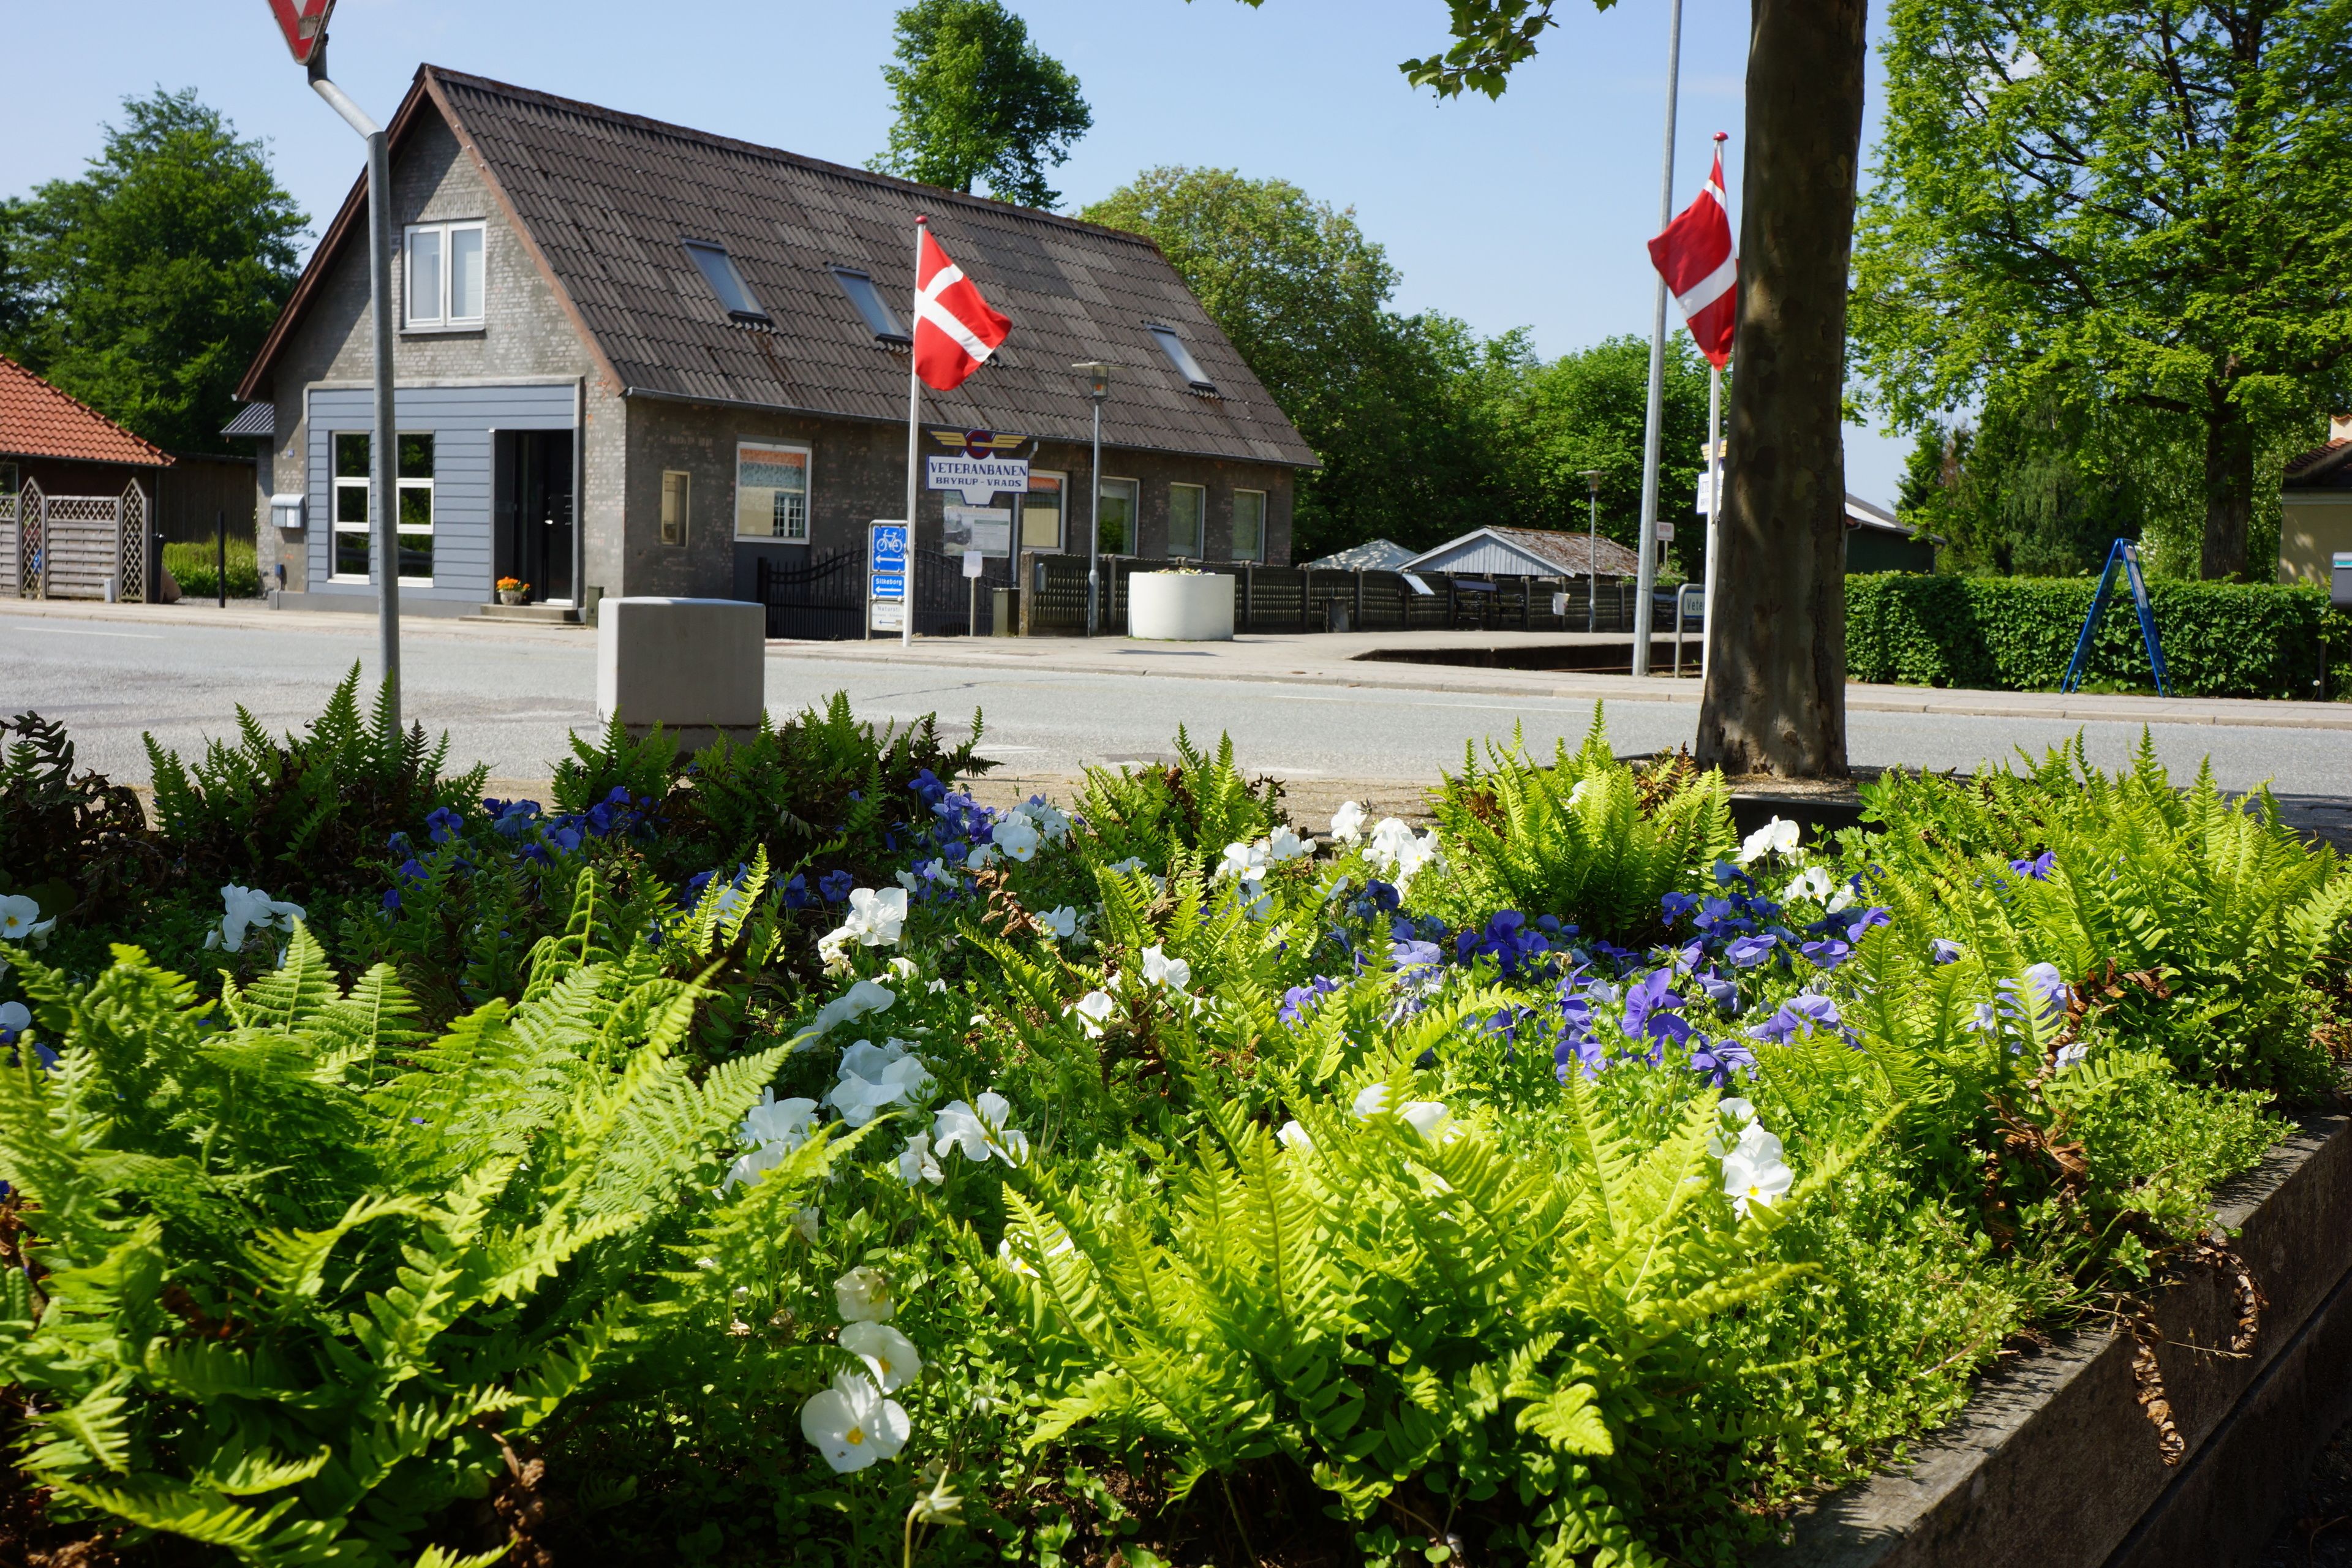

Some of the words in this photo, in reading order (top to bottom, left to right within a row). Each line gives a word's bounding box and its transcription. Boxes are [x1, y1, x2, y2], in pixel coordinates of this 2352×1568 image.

[930, 462, 1027, 476] VETERANBANEN
[936, 477, 978, 485] BRYRUP
[875, 578, 902, 586] Silkeborg
[1687, 598, 1704, 611] Vete
